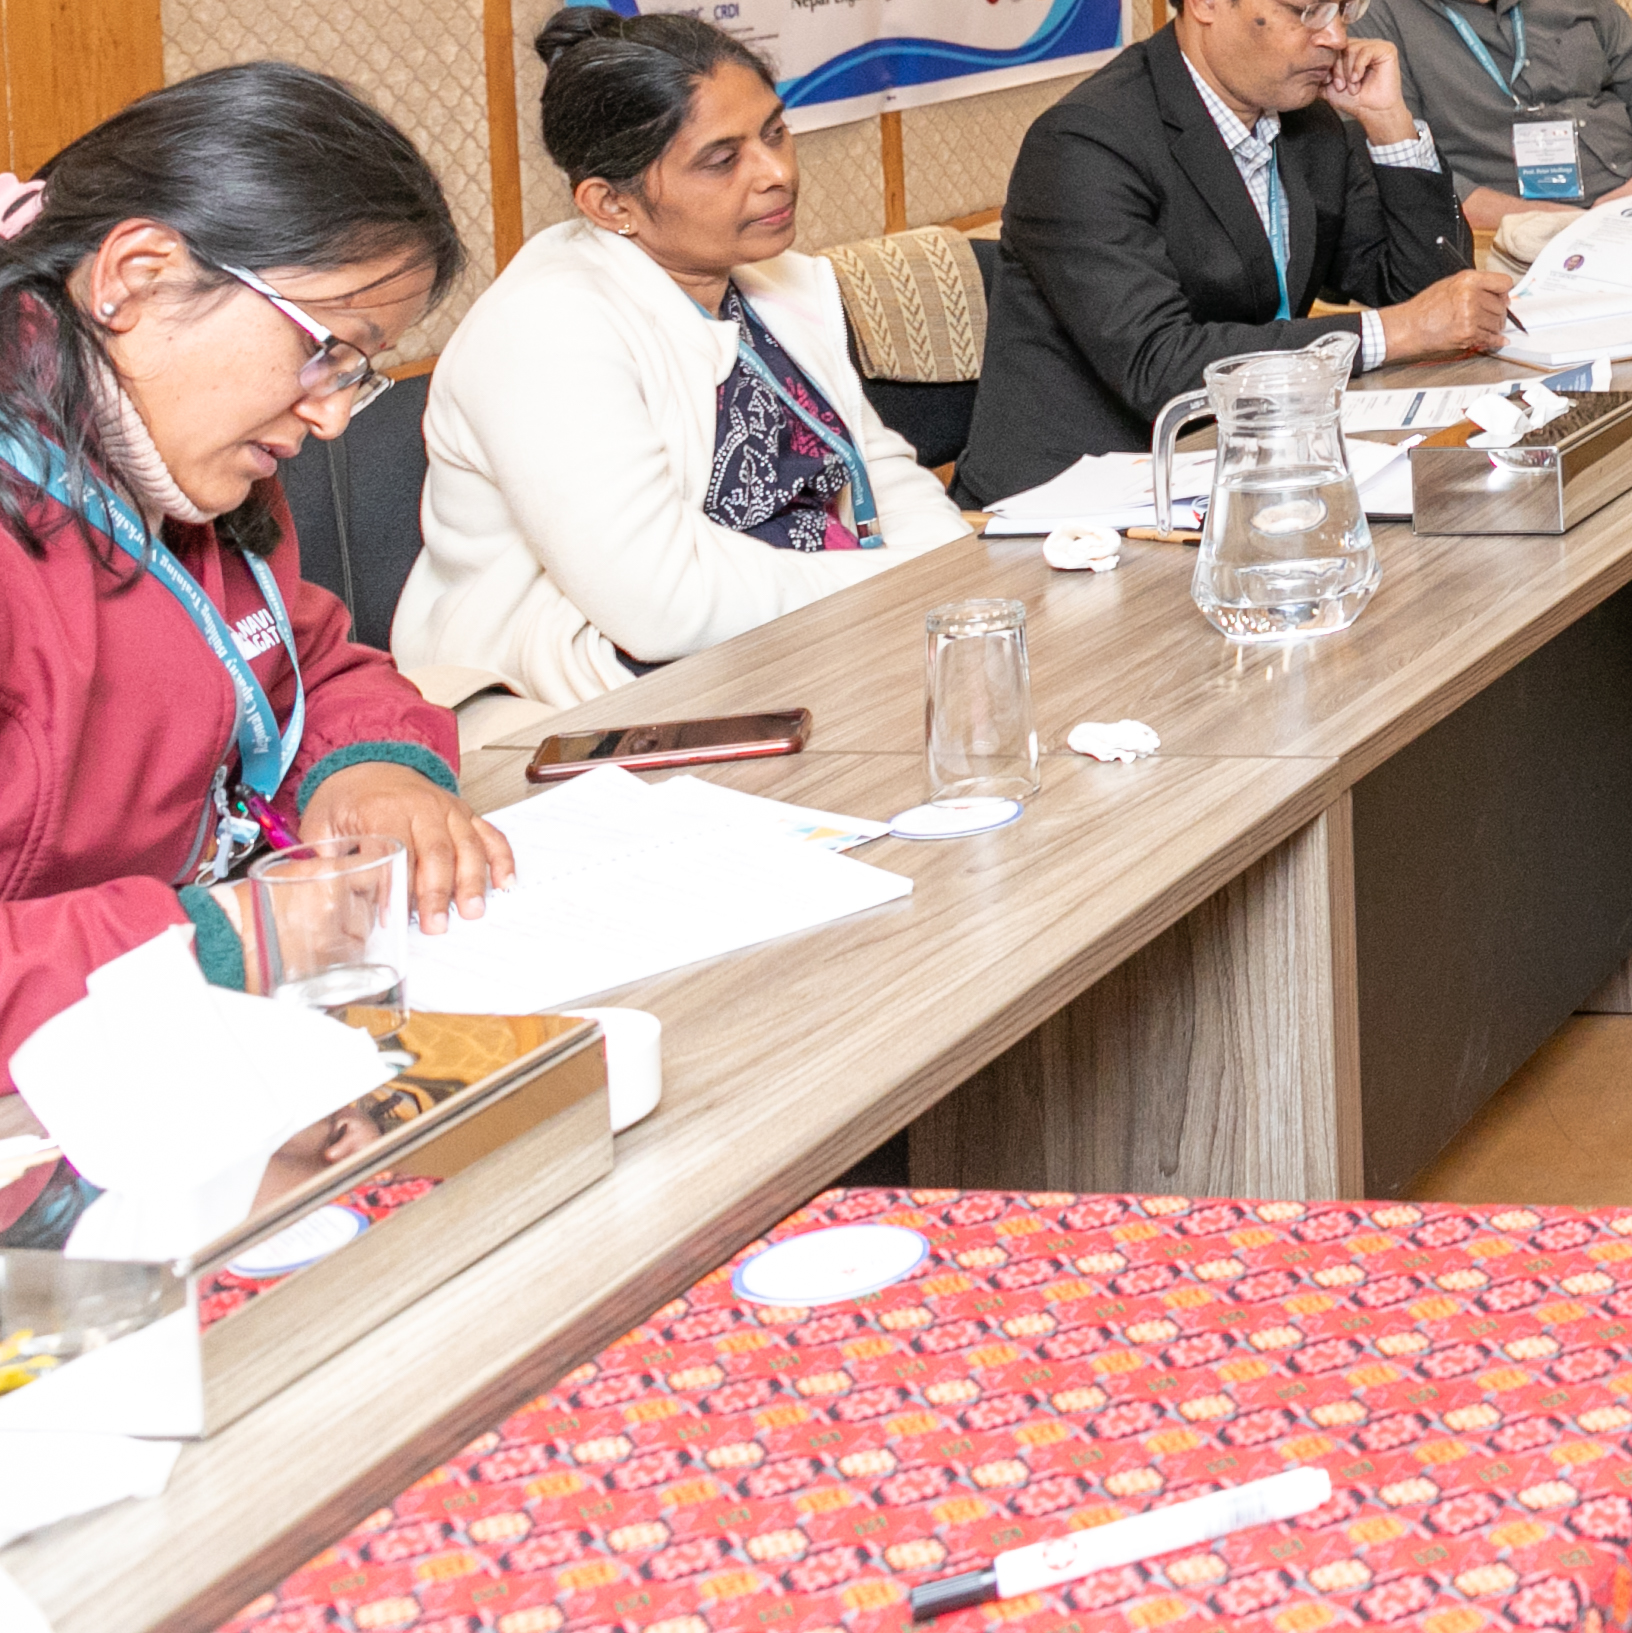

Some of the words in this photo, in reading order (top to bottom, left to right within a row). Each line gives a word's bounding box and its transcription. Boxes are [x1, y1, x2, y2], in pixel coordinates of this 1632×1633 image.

[159, 554, 205, 612] Training
[200, 601, 229, 659] Building
[235, 608, 276, 639] NAVI
[225, 657, 257, 716] Capacity
[246, 711, 271, 755] Regional
